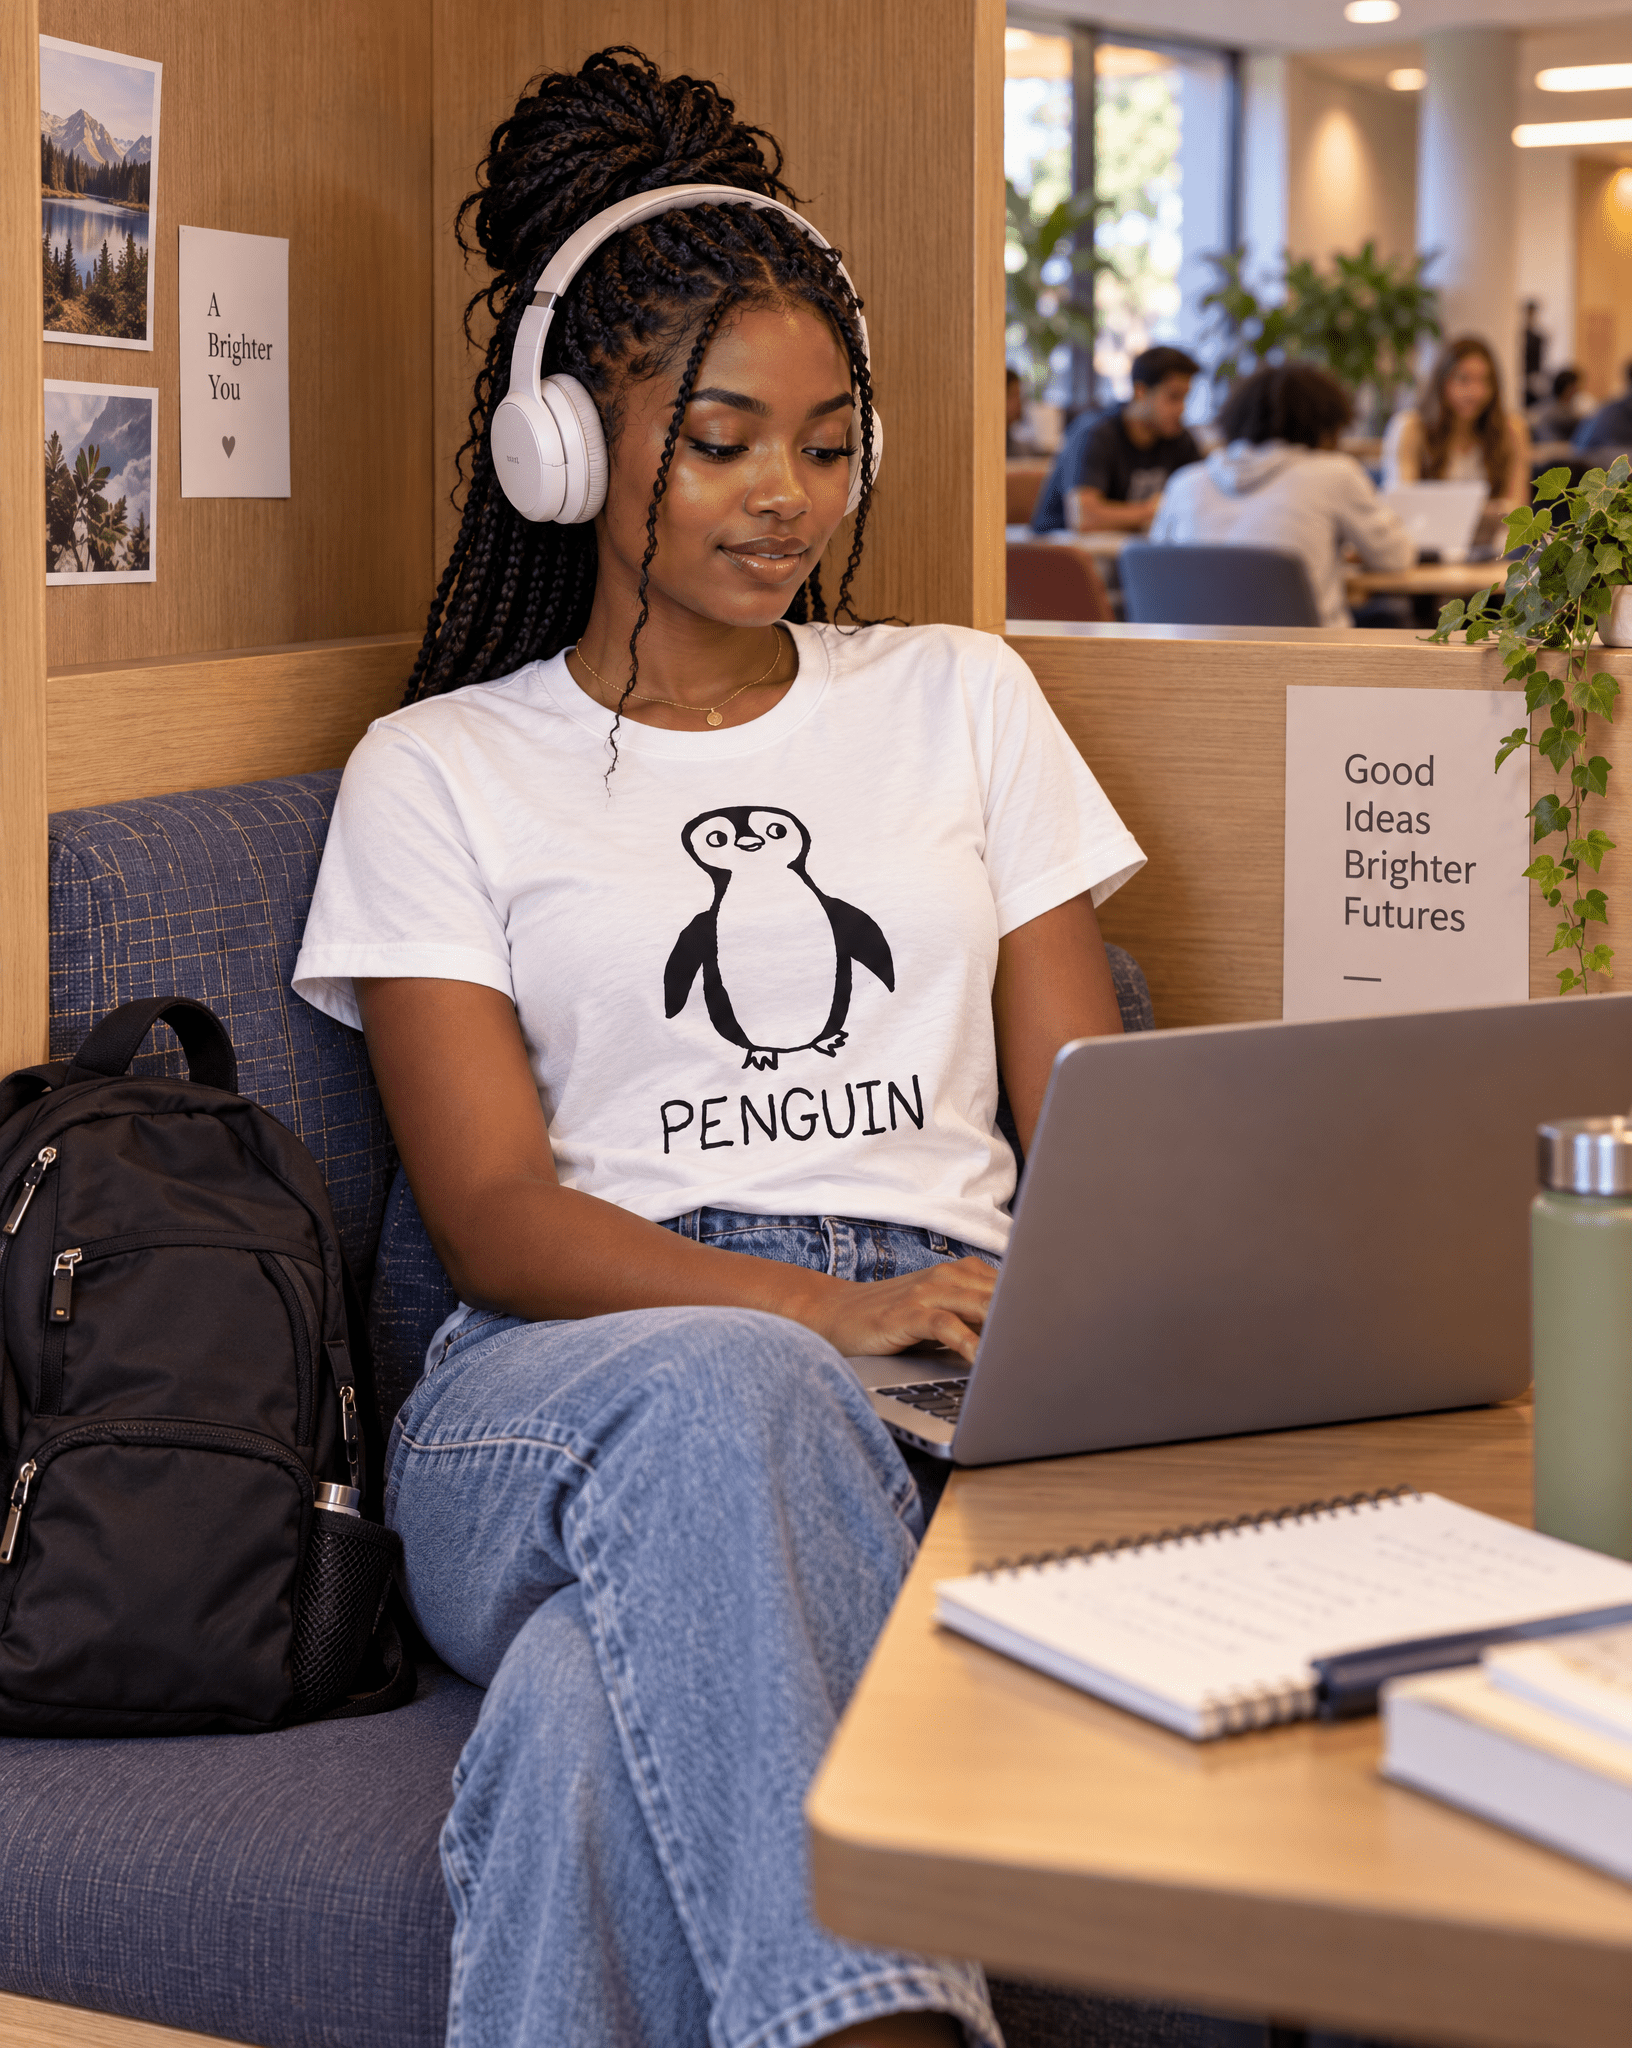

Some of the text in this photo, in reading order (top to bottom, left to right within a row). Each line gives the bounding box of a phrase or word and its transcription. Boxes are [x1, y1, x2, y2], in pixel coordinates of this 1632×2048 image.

[207, 292, 221, 317] A
[208, 333, 273, 366] Brighter
[208, 374, 240, 400] You
[1345, 754, 1434, 786] Good
[1346, 801, 1430, 834] Ideas
[1346, 850, 1476, 889] Brighter
[1345, 897, 1465, 932] Futures
[660, 1074, 924, 1154] PENGUIN
